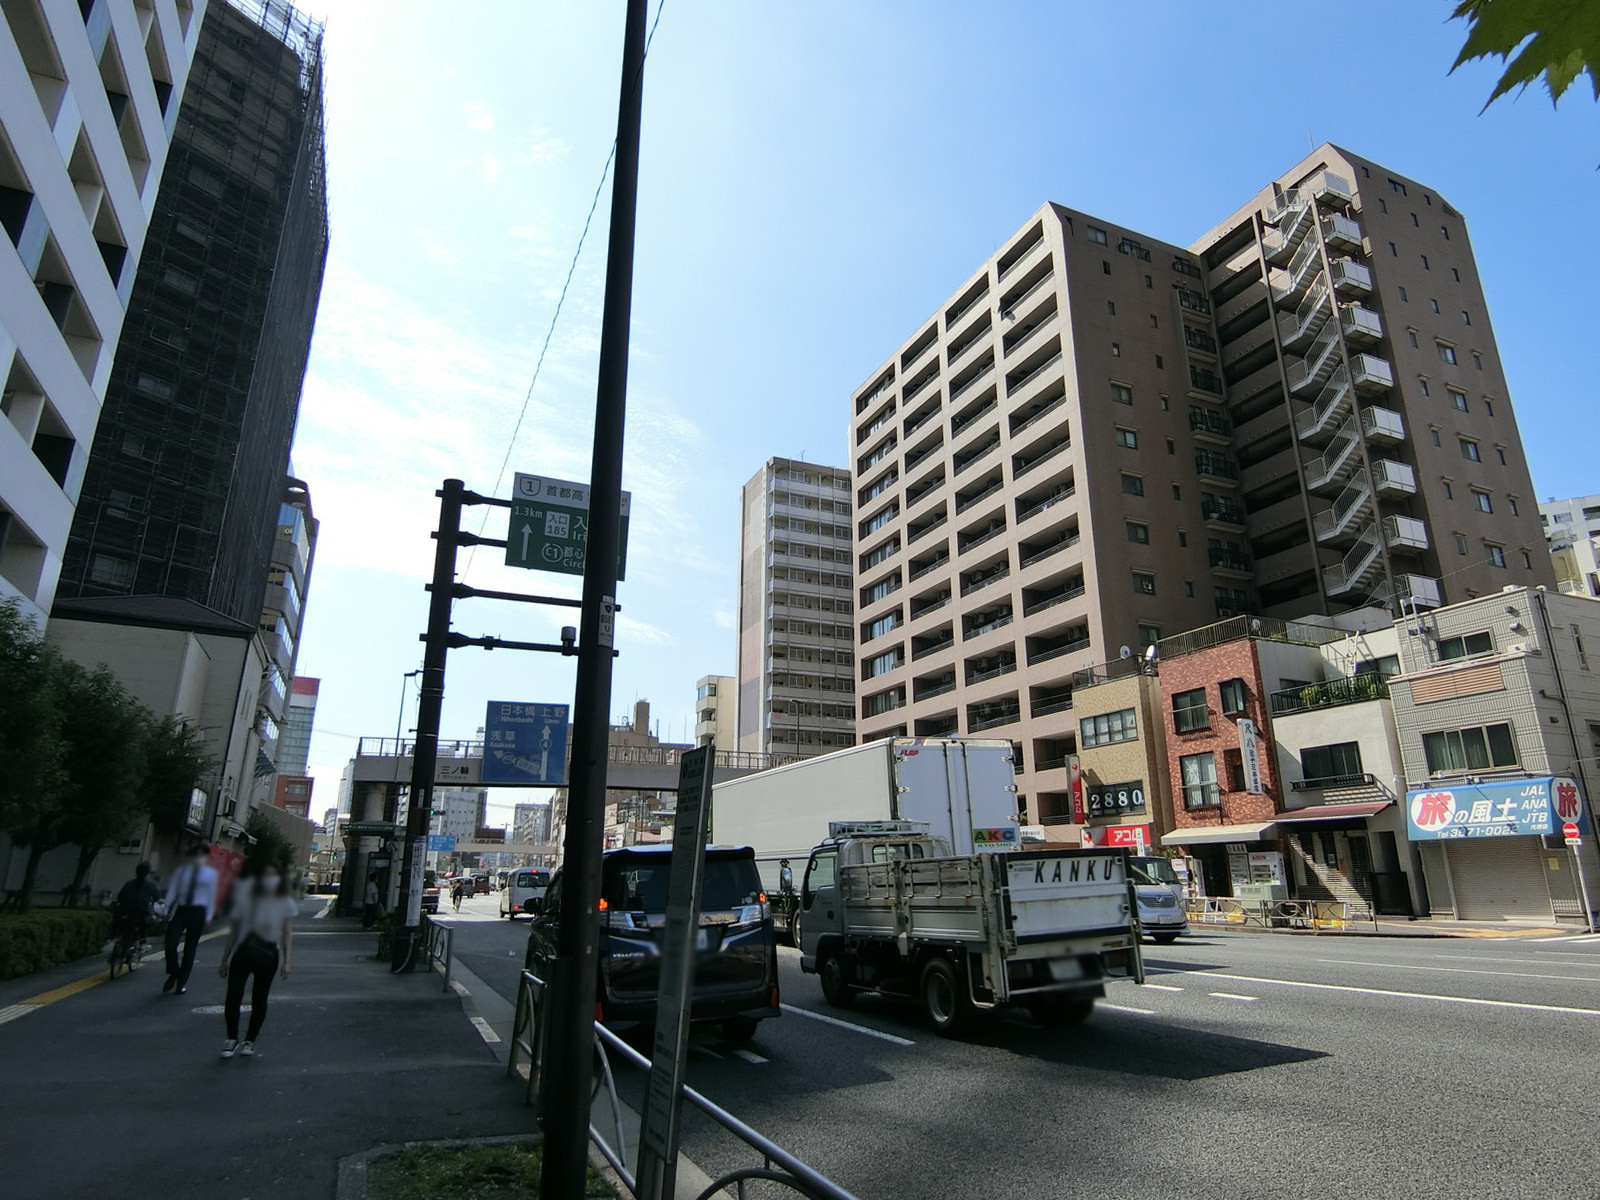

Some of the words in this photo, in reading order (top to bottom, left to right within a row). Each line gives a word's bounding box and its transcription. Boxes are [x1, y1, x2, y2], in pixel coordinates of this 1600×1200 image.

[525, 481, 534, 492] 1
[546, 485, 584, 502] 首都高
[514, 506, 543, 519] 1.3km
[548, 514, 568, 524] 入口
[573, 516, 588, 531] 入
[547, 525, 567, 536] 185
[563, 546, 584, 559] 都心
[1520, 785, 1545, 797] JAL
[1091, 789, 1144, 810] 2880
[1521, 798, 1547, 810] ANA
[1556, 781, 1578, 818] 旅
[1416, 792, 1518, 826] 旅の風土
[1522, 811, 1548, 824] JTB
[1437, 831, 1449, 839] Tel
[1034, 859, 1112, 884] KANKU
